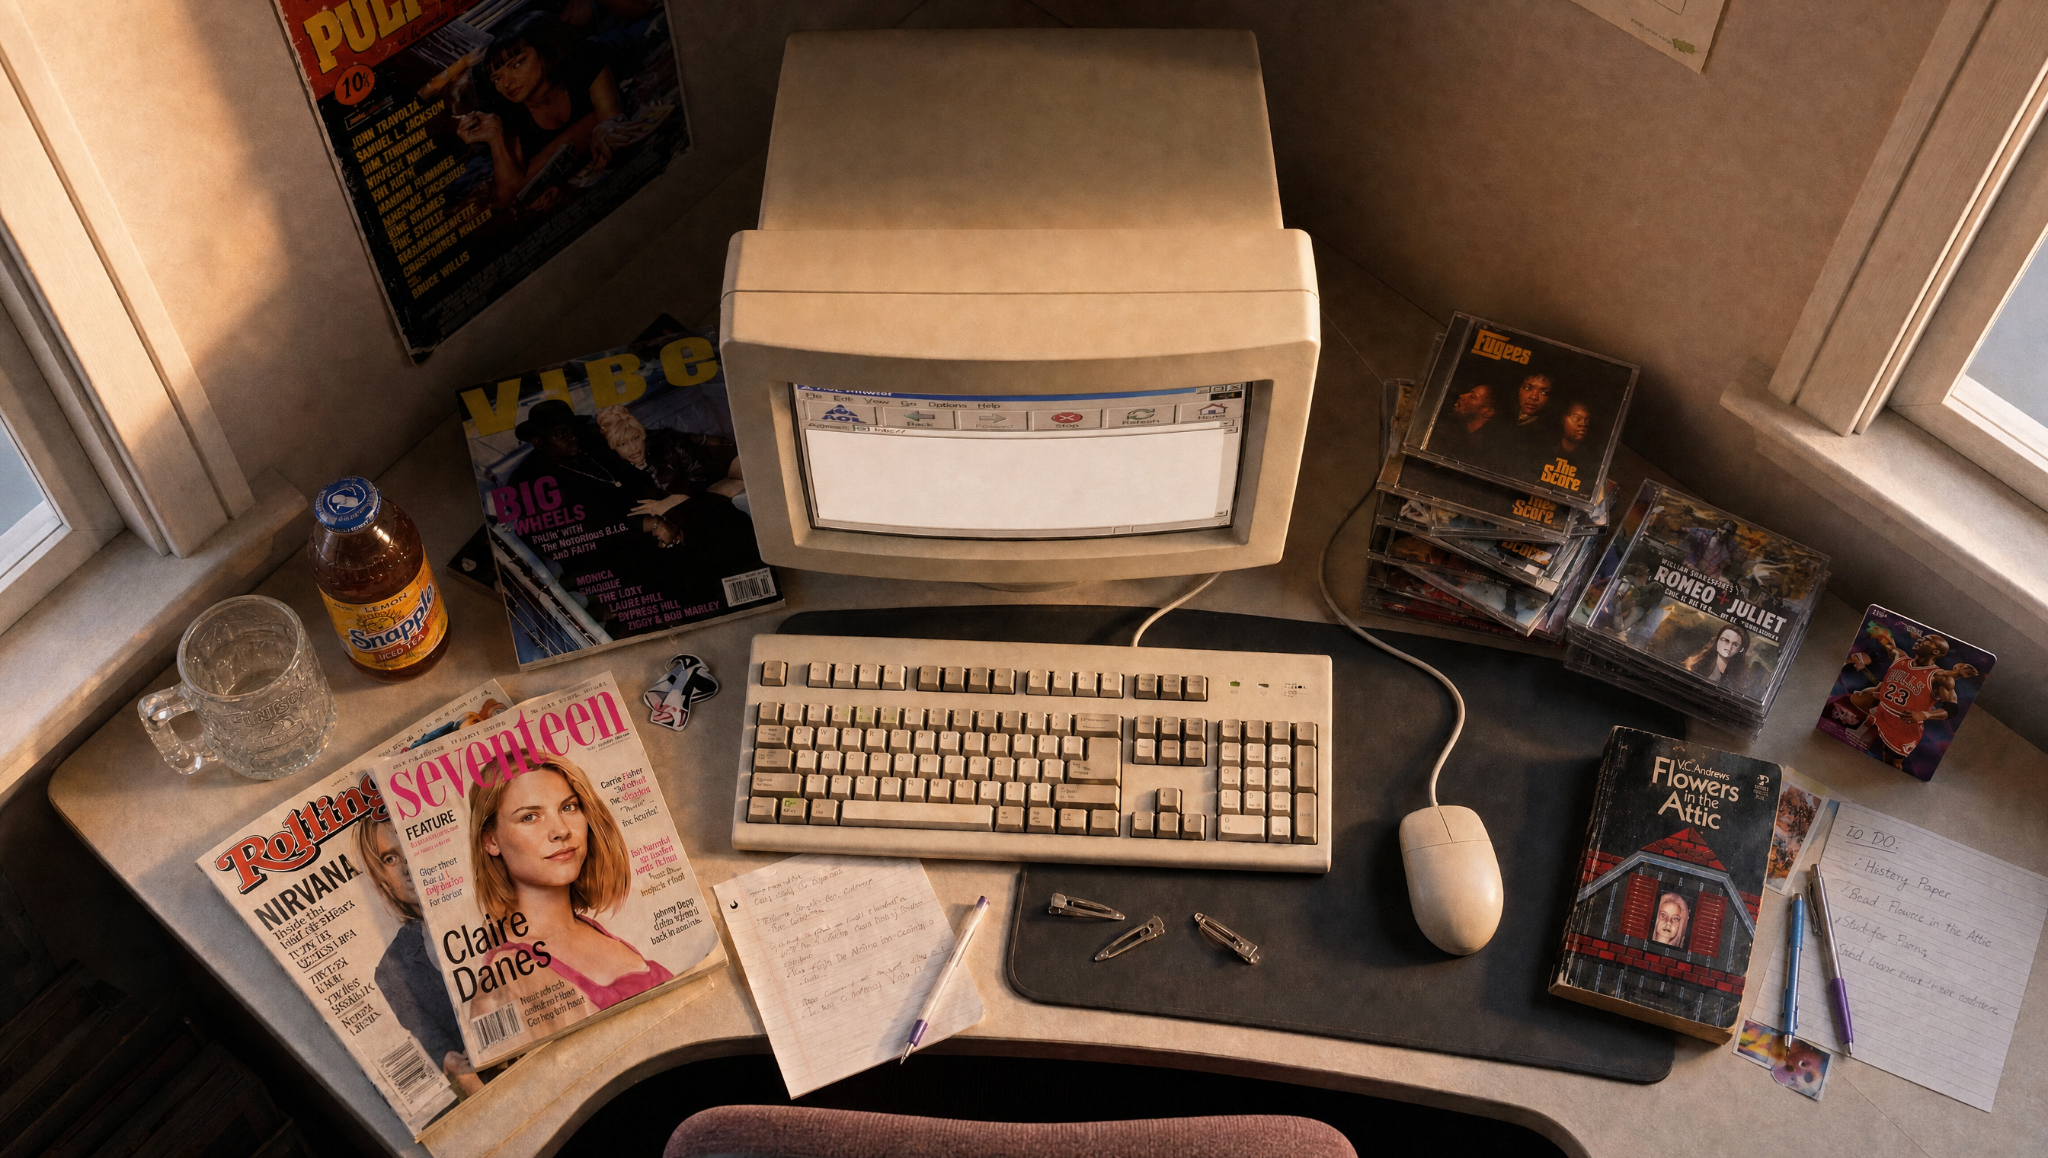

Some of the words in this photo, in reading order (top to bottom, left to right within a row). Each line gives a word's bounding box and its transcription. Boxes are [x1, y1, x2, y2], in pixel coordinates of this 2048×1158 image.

[352, 130, 376, 150] JOHN
[356, 135, 393, 163] SAMUEL
[405, 99, 445, 134] JACKSON
[411, 273, 440, 300] BRUCE
[440, 251, 470, 278] WILLIS
[1471, 328, 1532, 365] Fugees
[1541, 464, 1581, 491] Score
[1554, 457, 1577, 477] The
[491, 475, 562, 524] BIG
[1513, 499, 1554, 524] Score
[513, 504, 586, 536] WHEELS
[605, 522, 629, 536] B.I.G.
[571, 541, 597, 555] FAITH
[576, 569, 614, 586] MONICA
[364, 592, 408, 613] LEMON
[597, 591, 617, 604] THE
[660, 600, 682, 612] HILL
[1654, 565, 1716, 604] ROMEO
[1727, 598, 1788, 633] JULIET
[349, 582, 435, 650] Snapple
[627, 617, 652, 631] ZIGGY
[654, 615, 663, 624] &
[664, 610, 683, 623] BOB
[684, 600, 720, 617] MARLEY
[406, 633, 425, 649] TEA
[1884, 683, 1910, 707] 23
[390, 691, 629, 821] seventeen
[600, 775, 622, 789] Carrie
[622, 767, 643, 782] Fisher
[1652, 756, 1740, 802] Flowers
[1658, 790, 1721, 829] Attic
[1684, 790, 1695, 803] in
[1699, 793, 1719, 809] the
[215, 773, 391, 895] Rolling
[405, 809, 456, 840] FEATURE
[254, 853, 363, 931] NIRVANA
[1918, 876, 1951, 899] Paper
[653, 902, 678, 921] Johnny
[676, 896, 696, 912] Depp
[443, 911, 529, 964] Claire
[650, 930, 669, 945] back
[1929, 917, 1940, 928] in
[1945, 922, 1961, 937] the
[1966, 929, 1992, 949] Attic
[452, 940, 552, 1003] Danes
